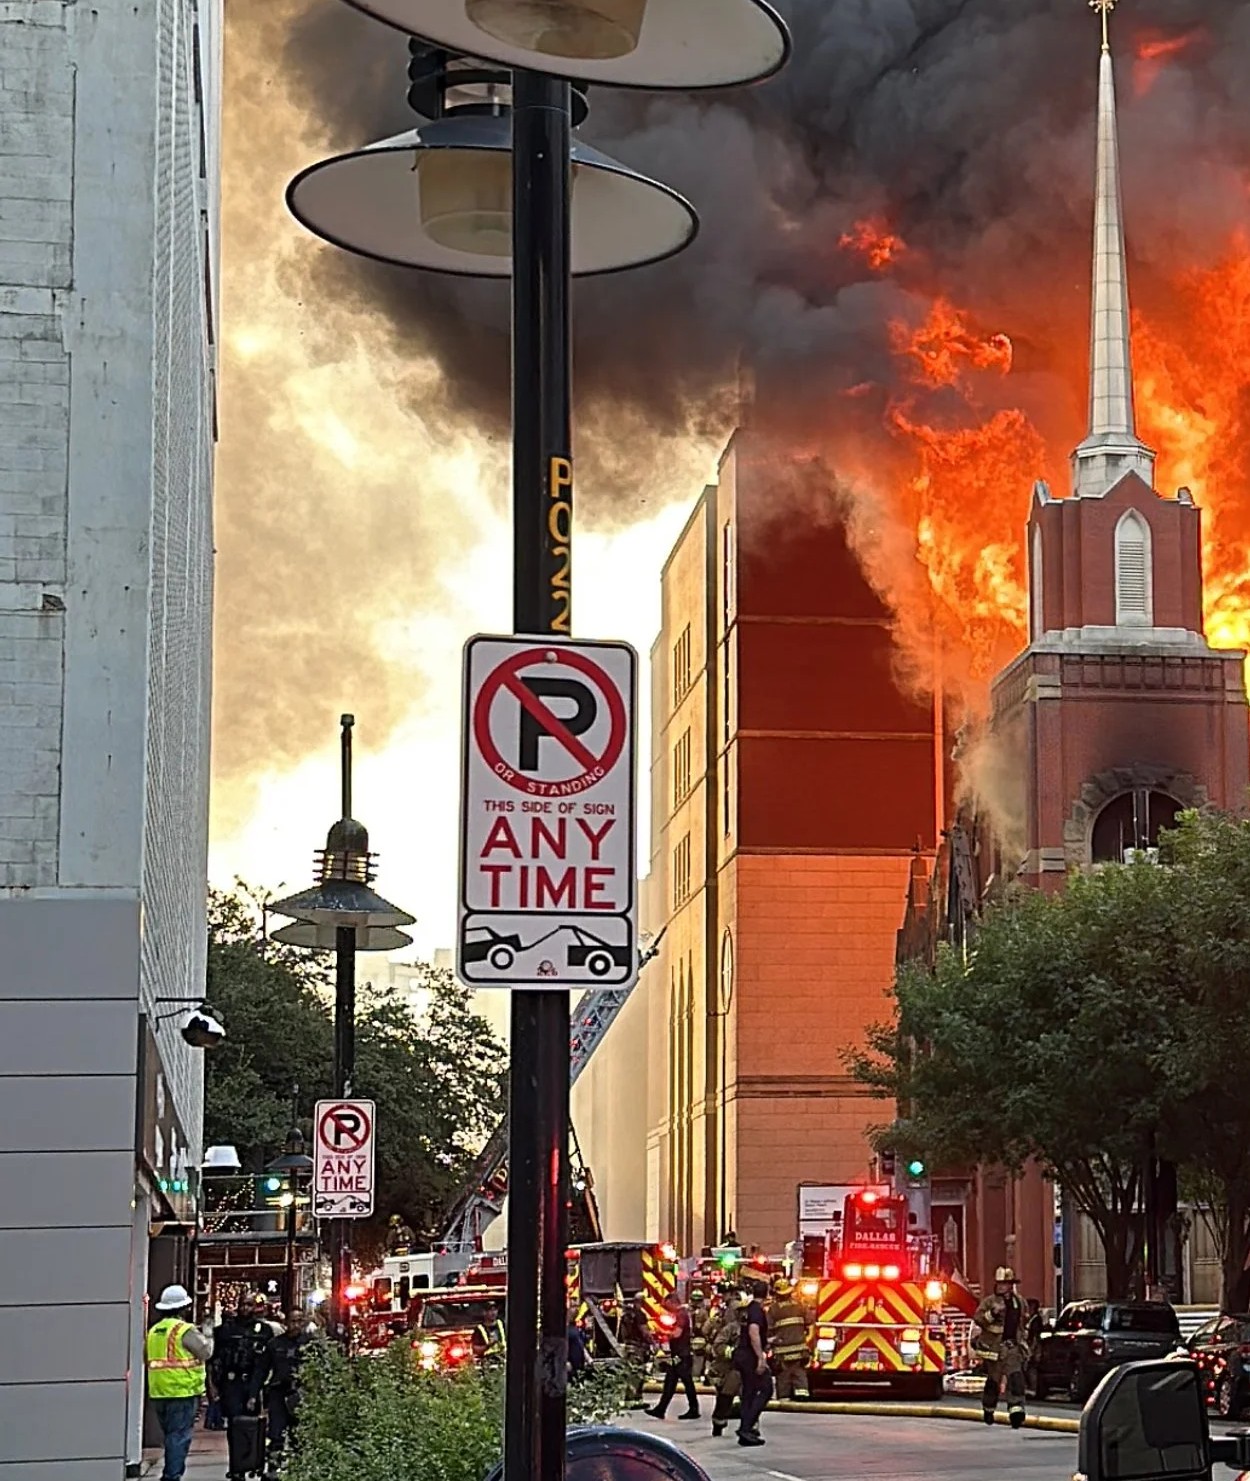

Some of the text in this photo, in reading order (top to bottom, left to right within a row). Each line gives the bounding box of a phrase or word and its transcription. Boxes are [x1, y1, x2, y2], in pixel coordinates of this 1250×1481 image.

[494, 762, 605, 795] OR STANDING
[484, 800, 615, 815] THIS SIDE OF SIGN
[480, 815, 617, 860] ANY
[480, 864, 616, 910] TIME
[321, 1160, 366, 1175] ANY
[321, 1176, 367, 1191] TIME
[855, 1231, 896, 1242] DALLAS
